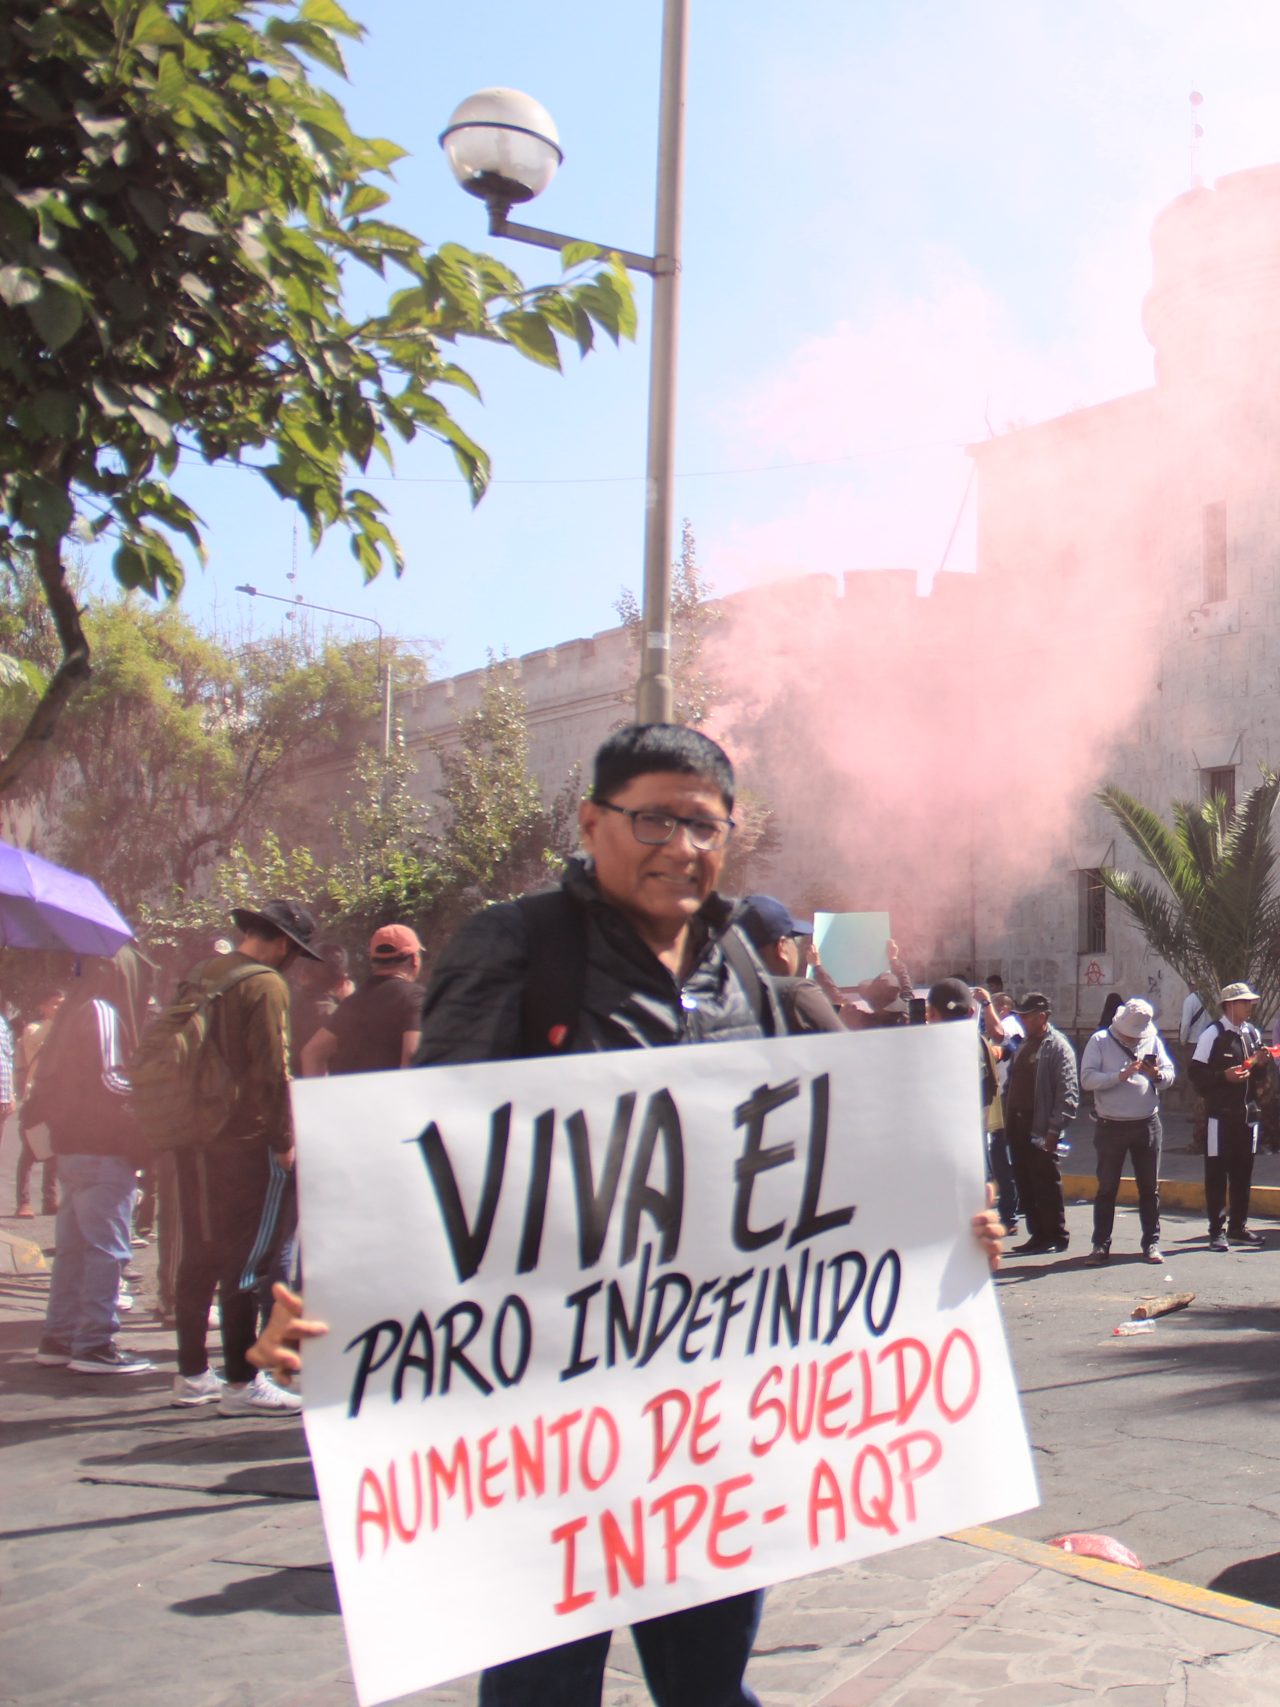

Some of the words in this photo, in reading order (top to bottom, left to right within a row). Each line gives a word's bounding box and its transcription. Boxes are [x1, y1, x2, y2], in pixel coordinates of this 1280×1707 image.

[402, 1087, 685, 1283] VIVA
[733, 1073, 856, 1253] EL
[344, 1294, 533, 1418] PARO
[560, 1243, 902, 1382] INDEFINIDO
[356, 1406, 621, 1560] AUMENTO
[642, 1380, 723, 1484] DE
[748, 1328, 982, 1457] SUELDO
